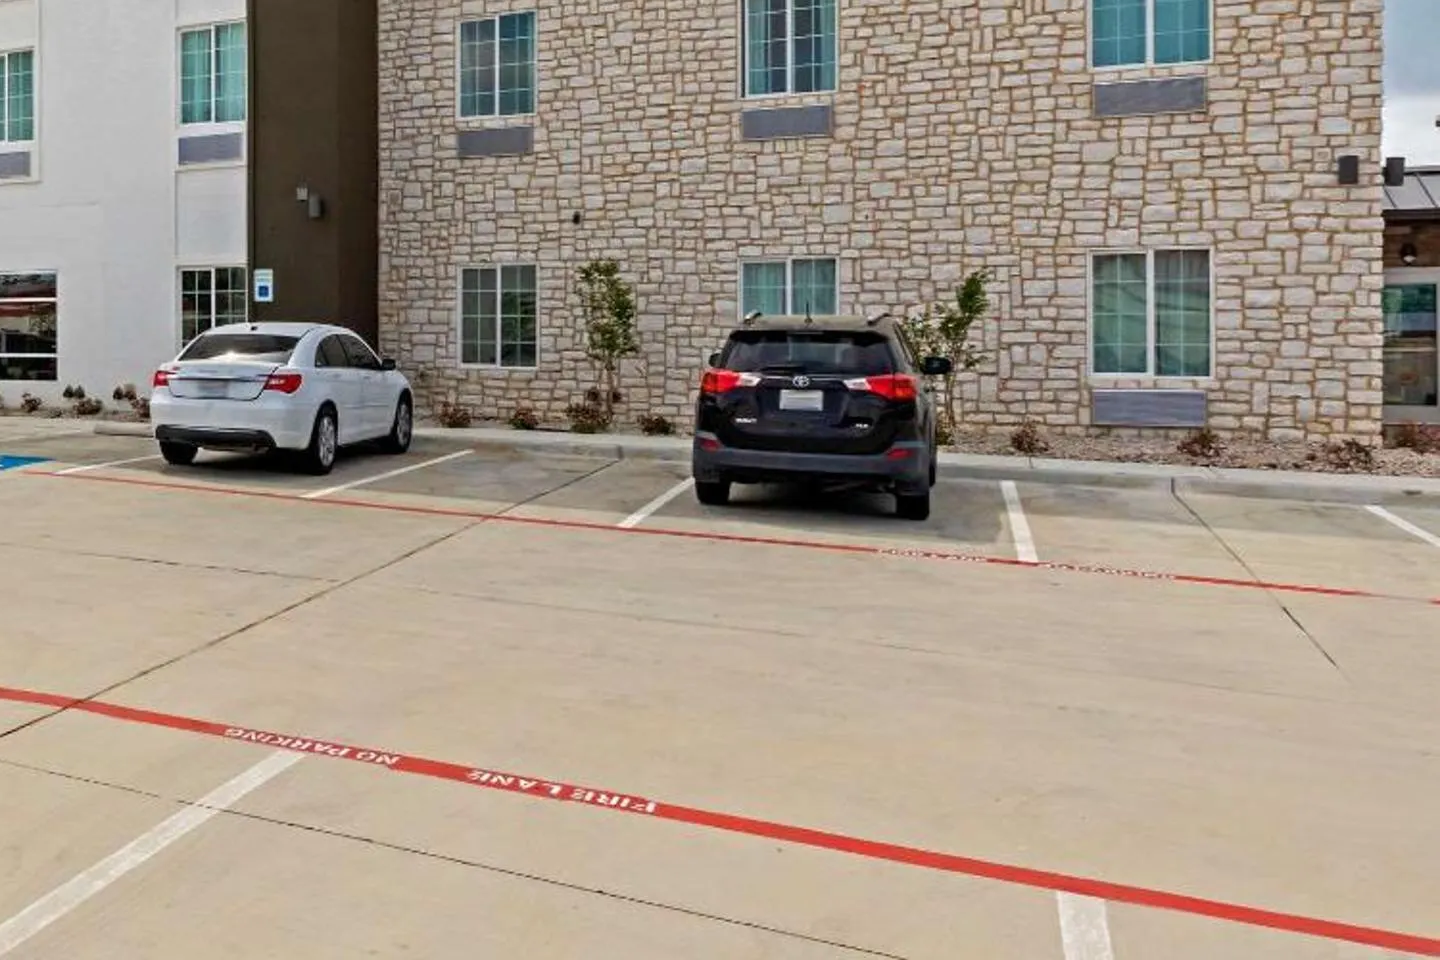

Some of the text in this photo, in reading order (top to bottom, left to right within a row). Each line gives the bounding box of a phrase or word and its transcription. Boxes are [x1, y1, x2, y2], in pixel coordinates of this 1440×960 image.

[225, 728, 400, 765] NO PARKING
[468, 770, 657, 813] FIRE LANE
